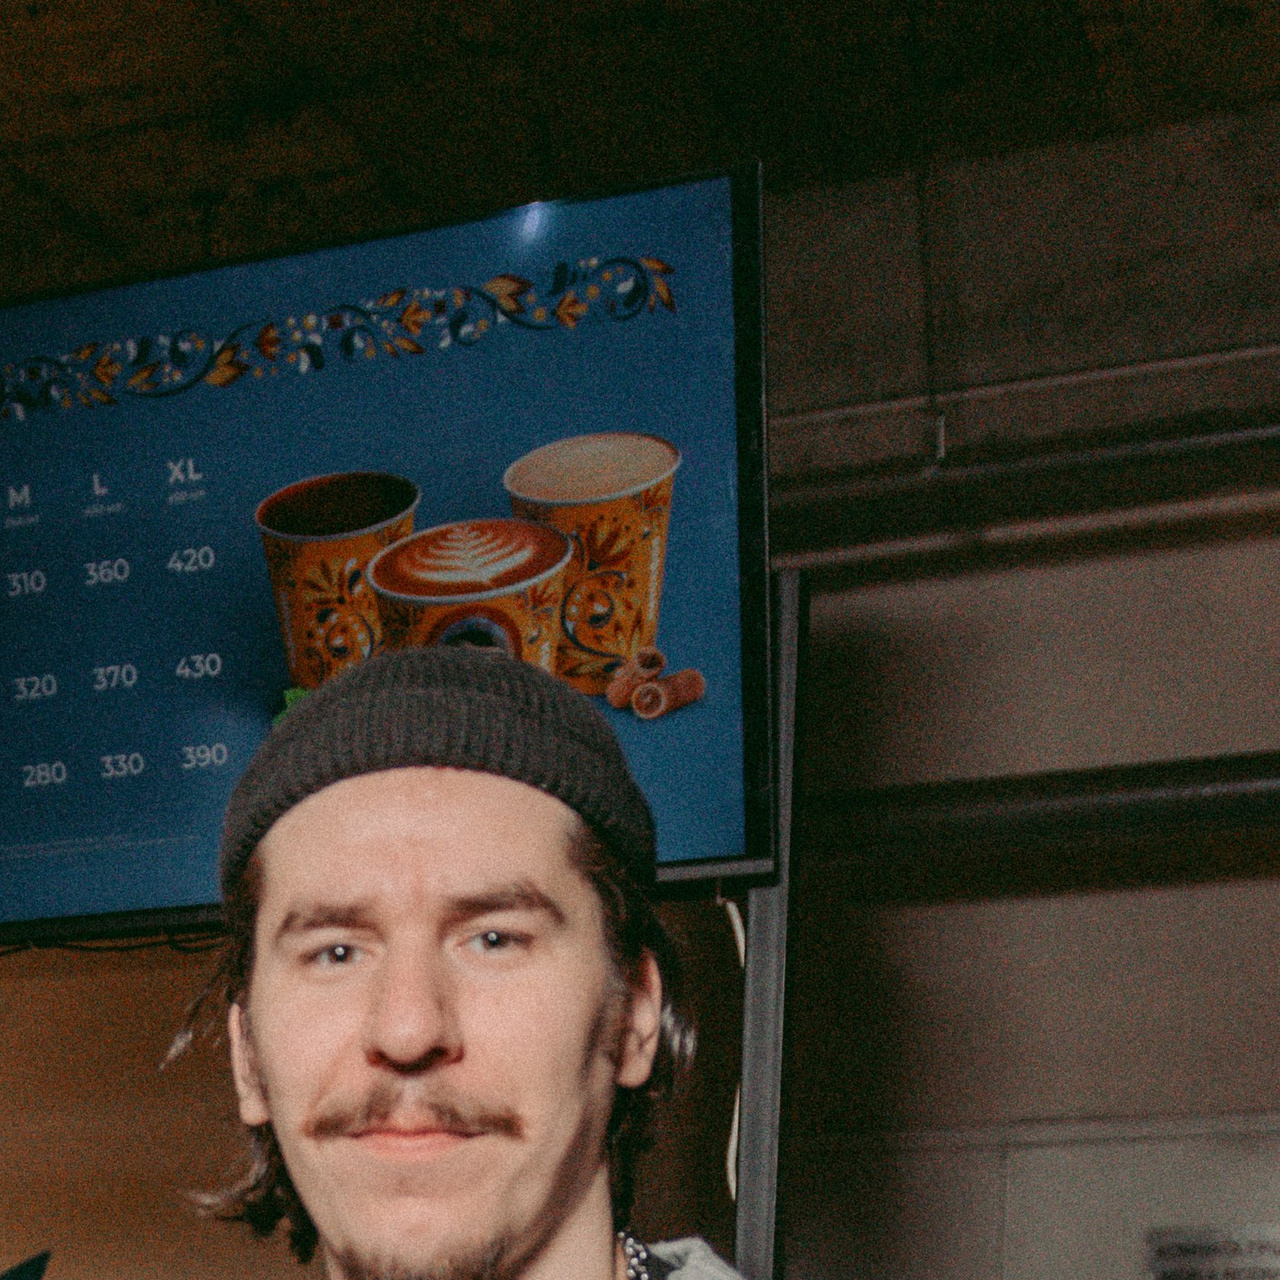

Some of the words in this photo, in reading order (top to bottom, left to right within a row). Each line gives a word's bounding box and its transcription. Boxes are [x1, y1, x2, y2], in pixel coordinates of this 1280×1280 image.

[91, 472, 109, 497] L
[166, 458, 204, 484] XL
[7, 569, 47, 597] 310
[84, 557, 130, 586] 360
[166, 545, 215, 573] 420
[14, 673, 57, 701] 320
[92, 663, 138, 690] 370
[175, 653, 223, 679] 430
[23, 761, 67, 787] 280
[100, 752, 145, 778] 330
[182, 743, 229, 769] 390
